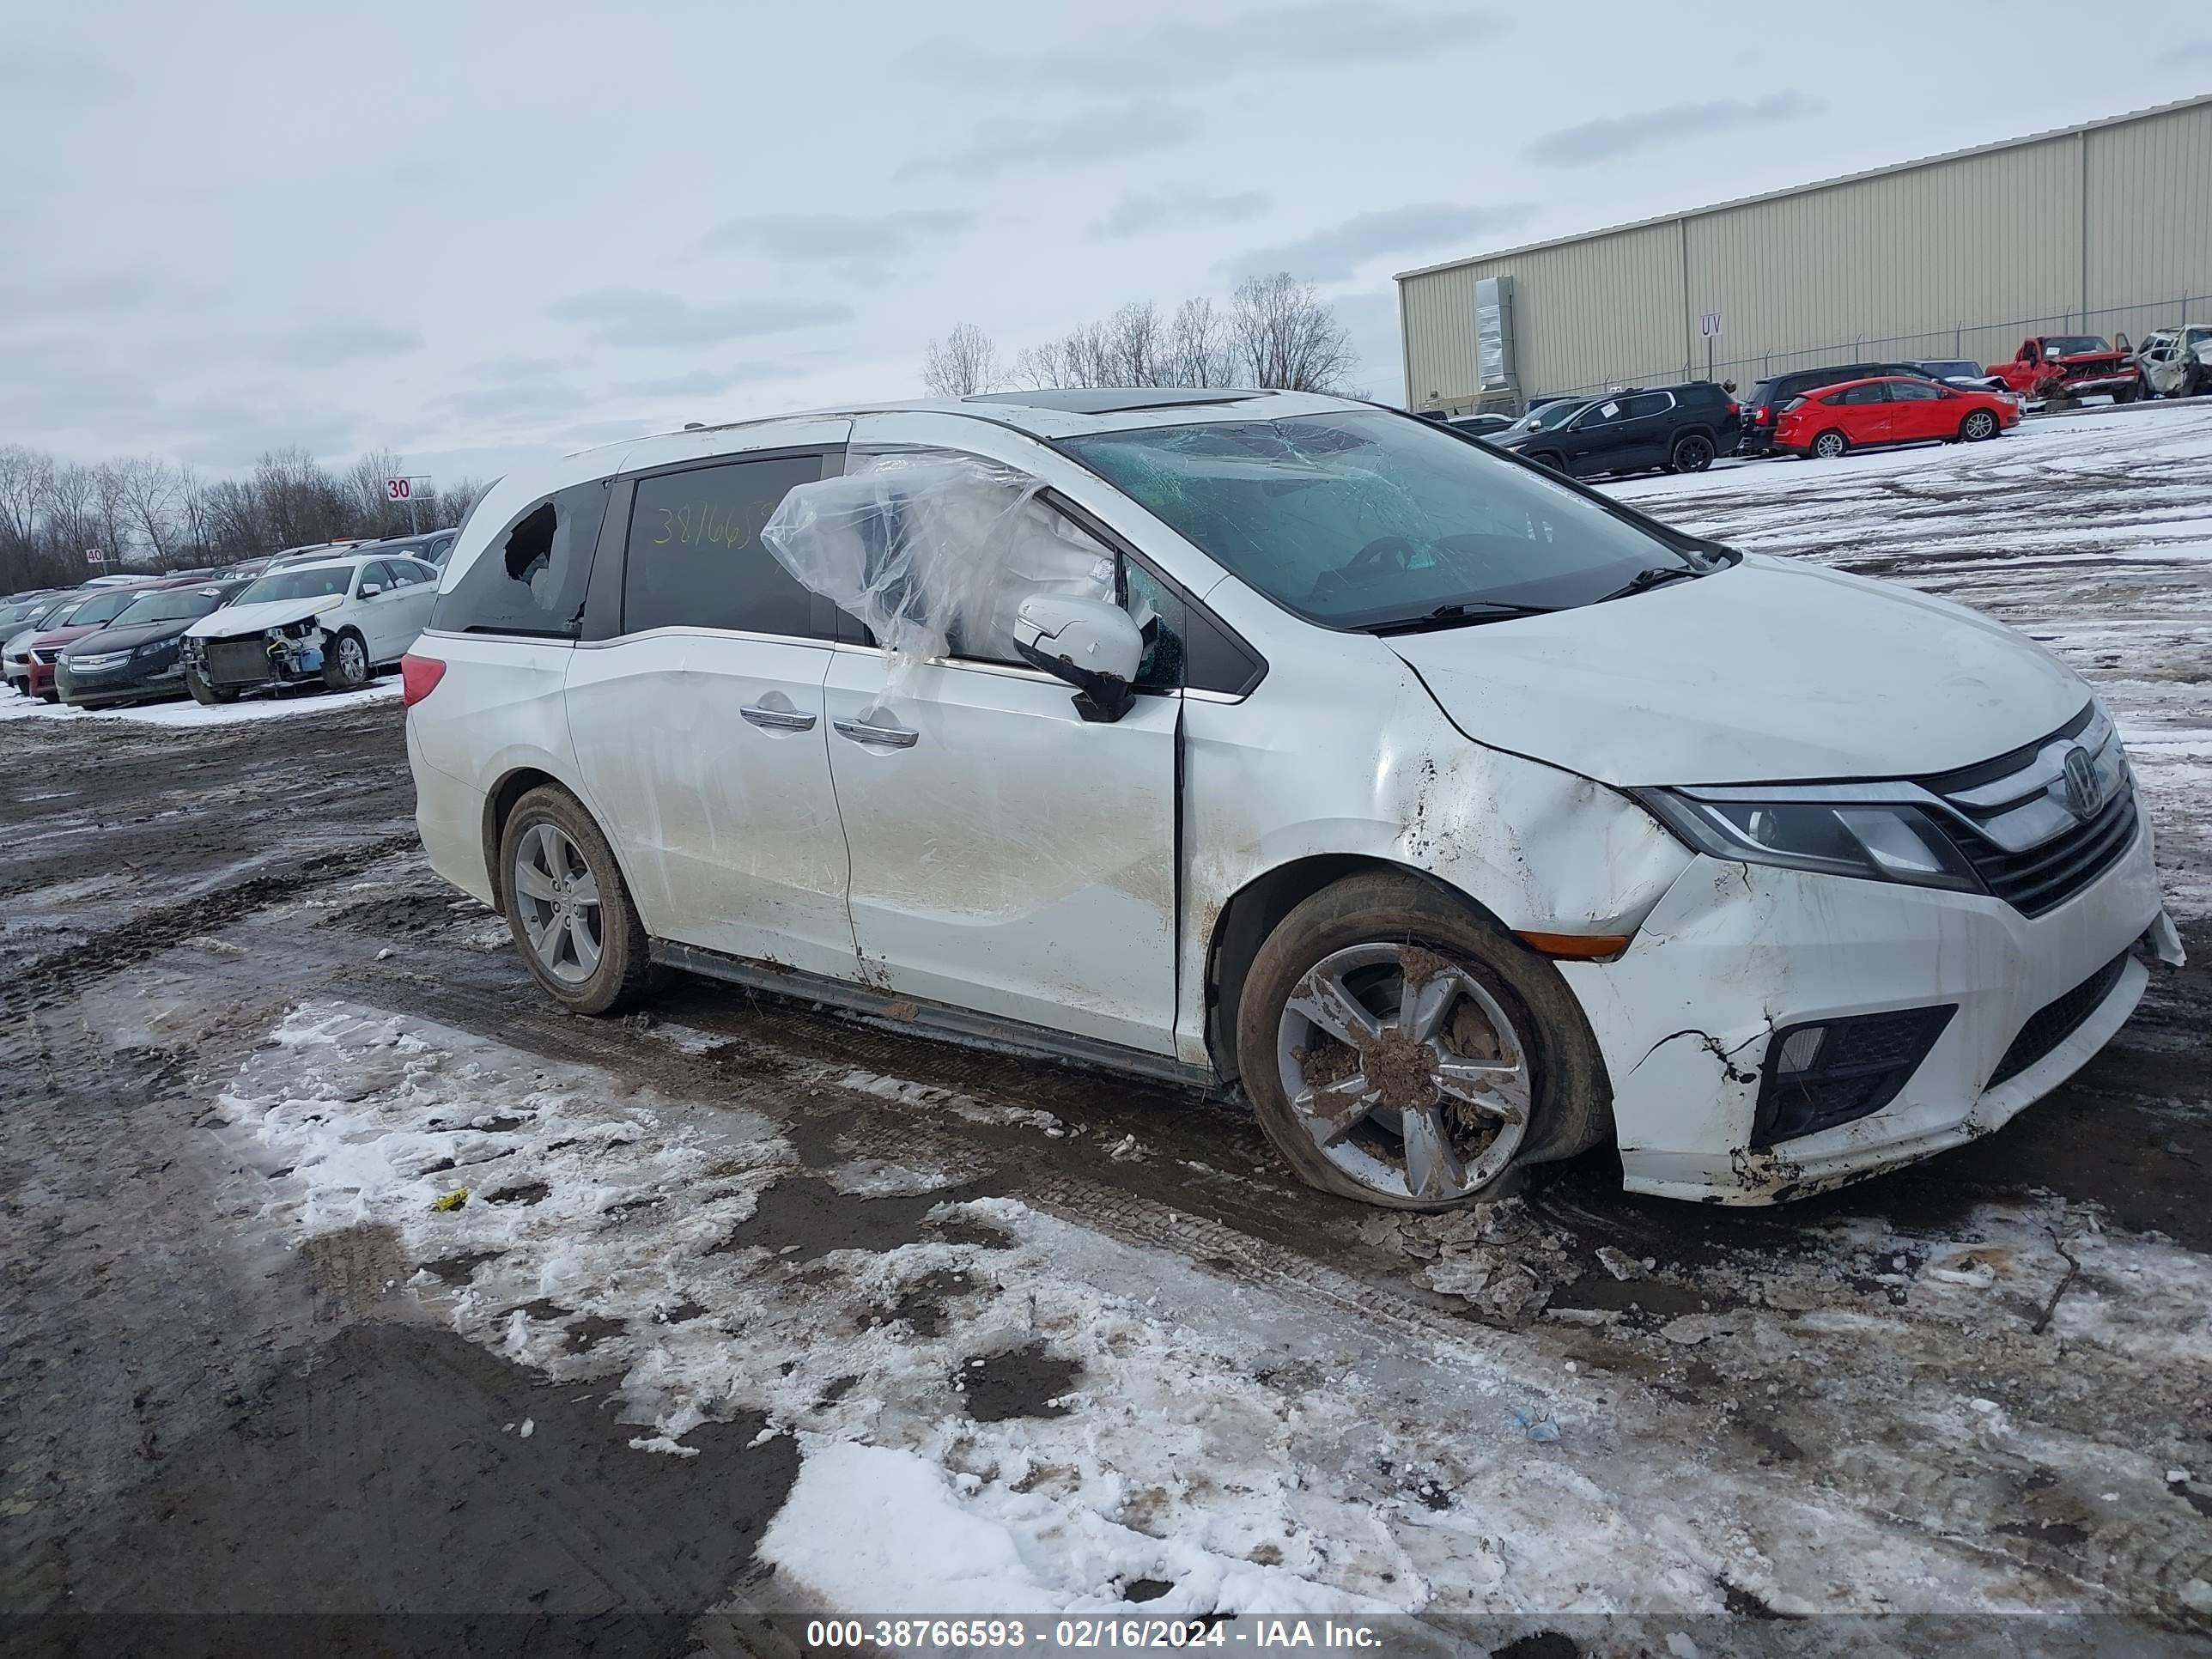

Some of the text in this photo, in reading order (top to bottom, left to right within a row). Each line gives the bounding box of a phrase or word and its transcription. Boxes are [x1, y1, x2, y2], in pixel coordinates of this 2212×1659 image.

[1702, 315, 1721, 336] UV
[387, 479, 410, 499] 30
[88, 550, 102, 562] 40
